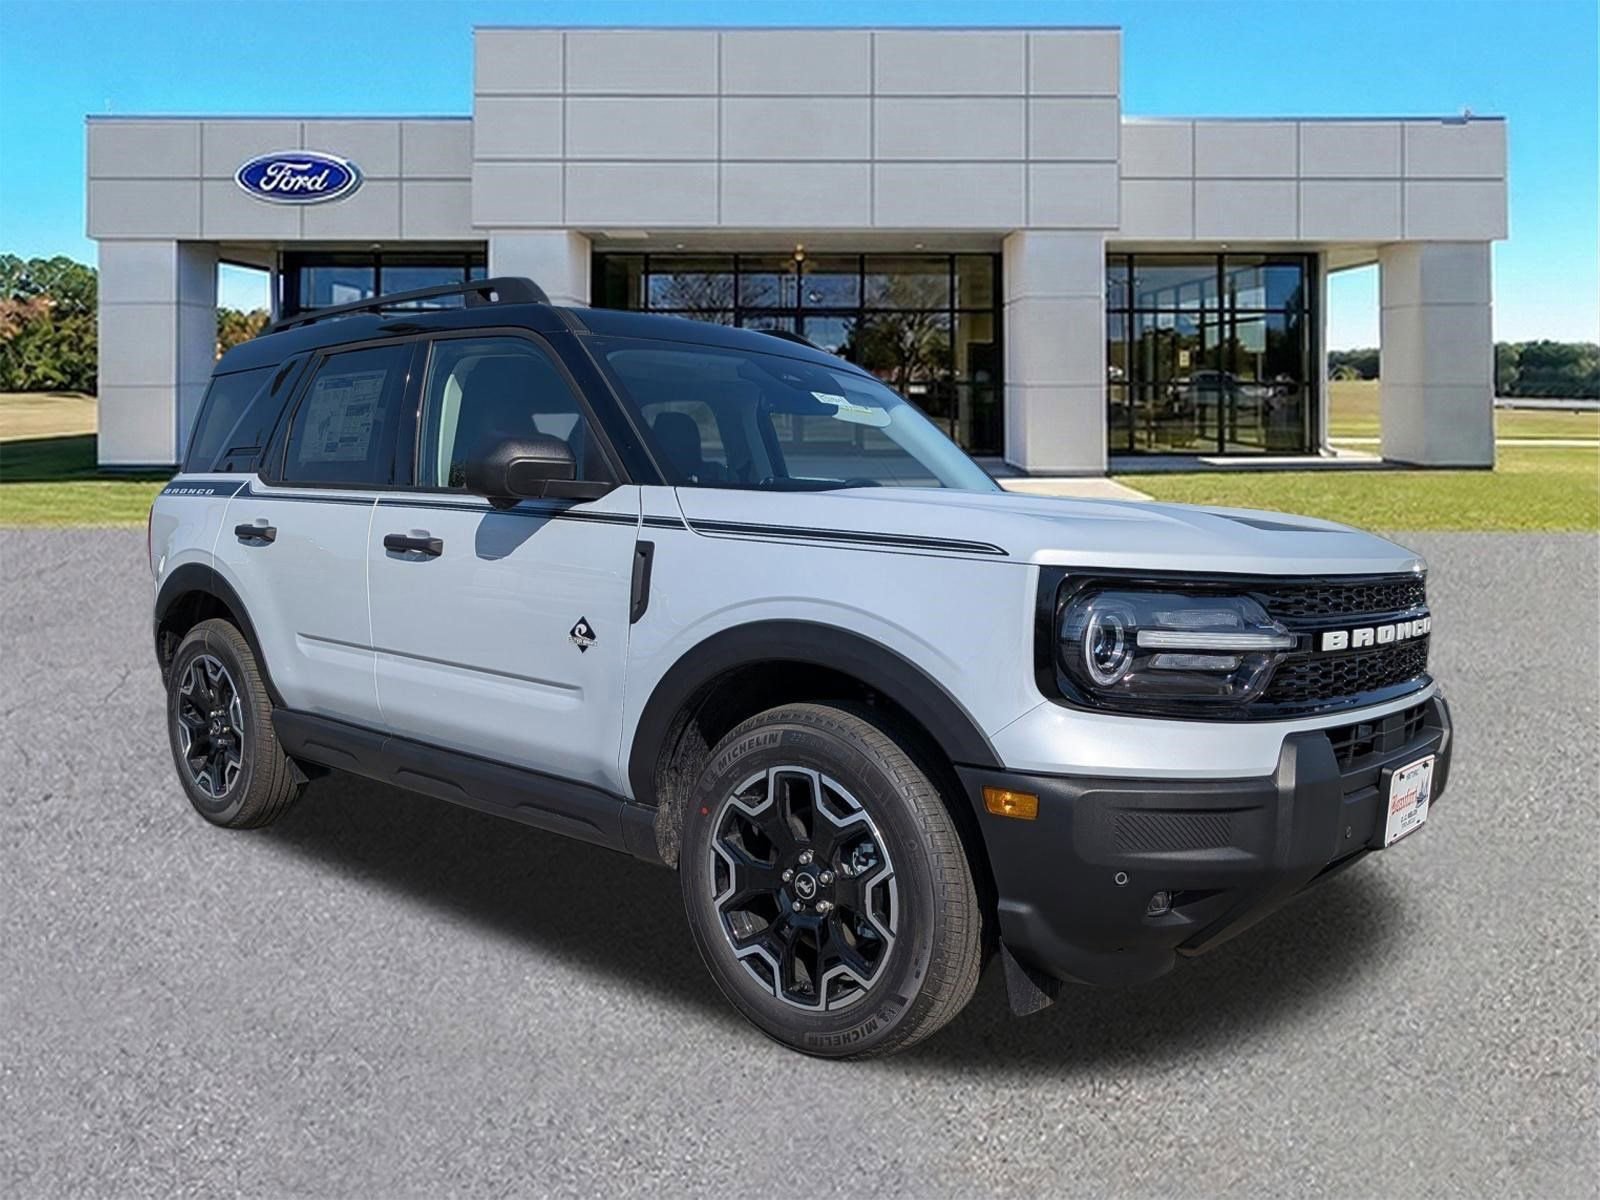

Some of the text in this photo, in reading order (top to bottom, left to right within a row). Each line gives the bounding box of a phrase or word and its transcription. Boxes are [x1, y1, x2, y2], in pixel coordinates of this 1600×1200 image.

[259, 161, 330, 191] Ford
[1321, 616, 1432, 652] BRONCO
[717, 730, 779, 771] MICHELIN
[807, 1018, 880, 1047] MICHELIN
